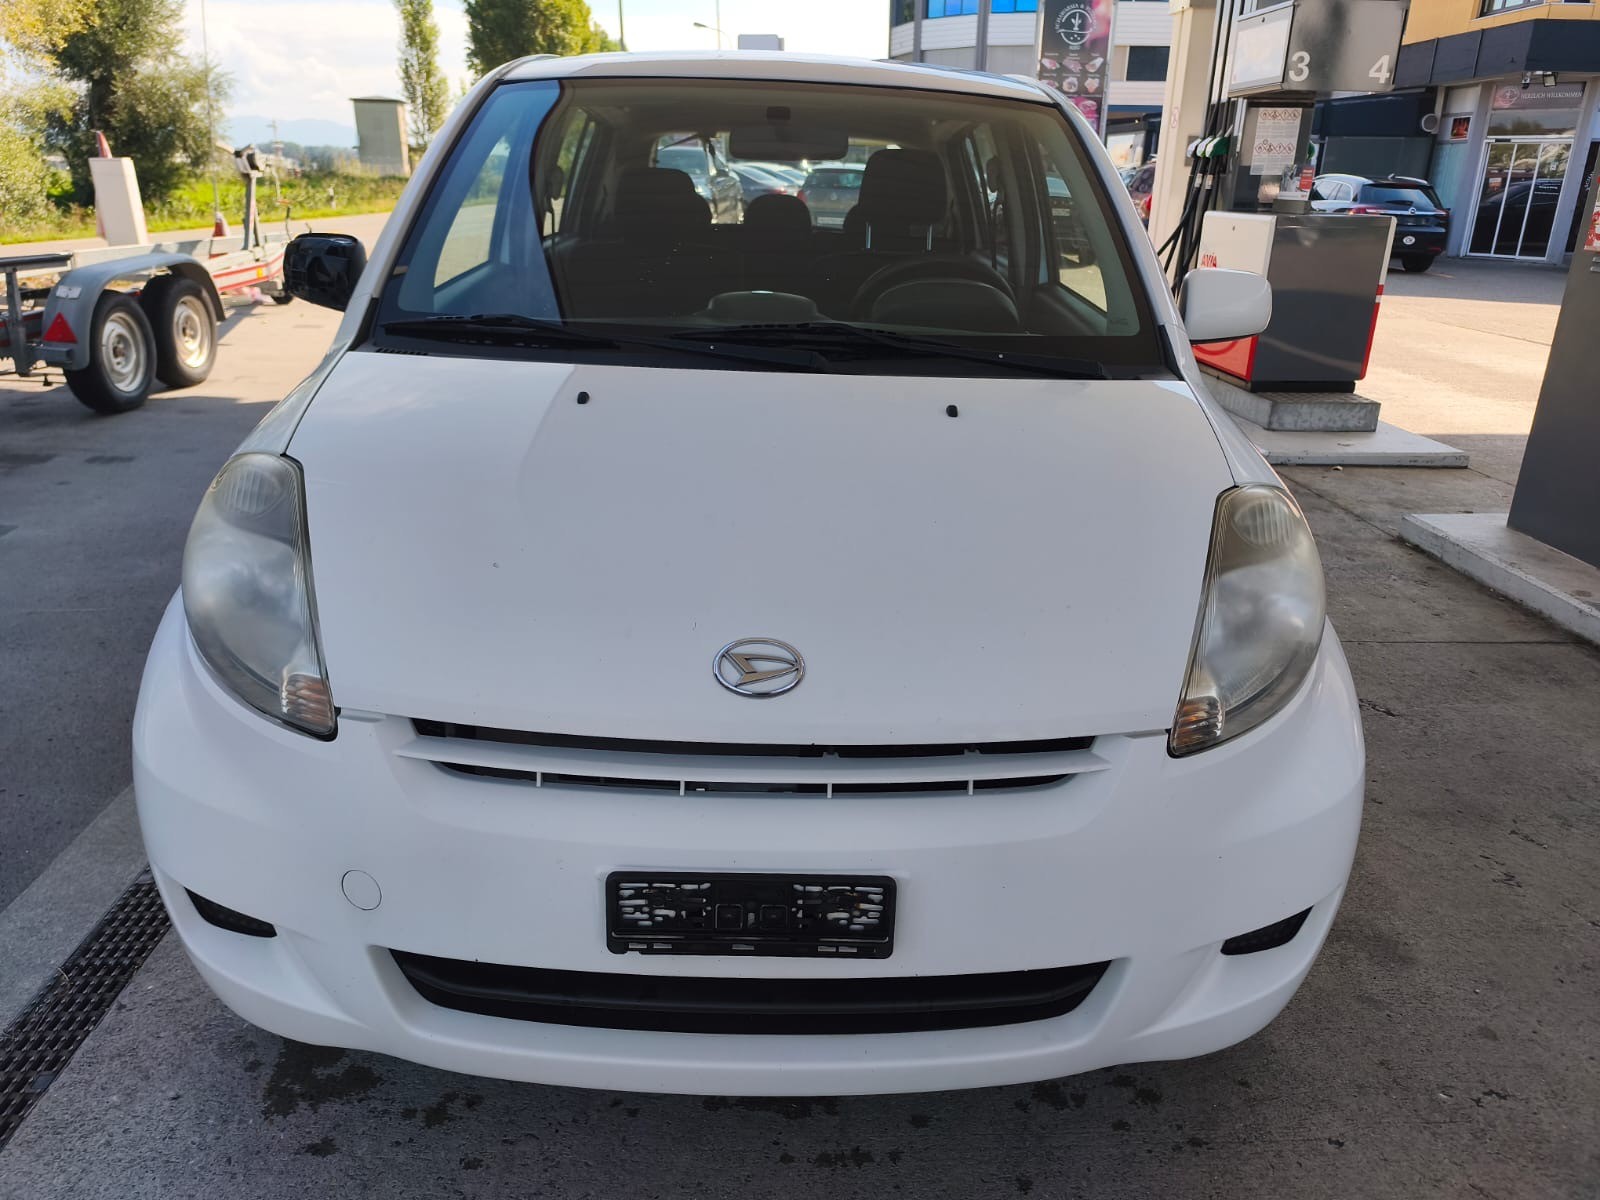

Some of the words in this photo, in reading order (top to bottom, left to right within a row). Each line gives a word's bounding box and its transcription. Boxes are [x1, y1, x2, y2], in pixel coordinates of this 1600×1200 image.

[1288, 50, 1311, 82] 3
[1368, 54, 1391, 84] 4
[1201, 253, 1217, 268] AVIA
